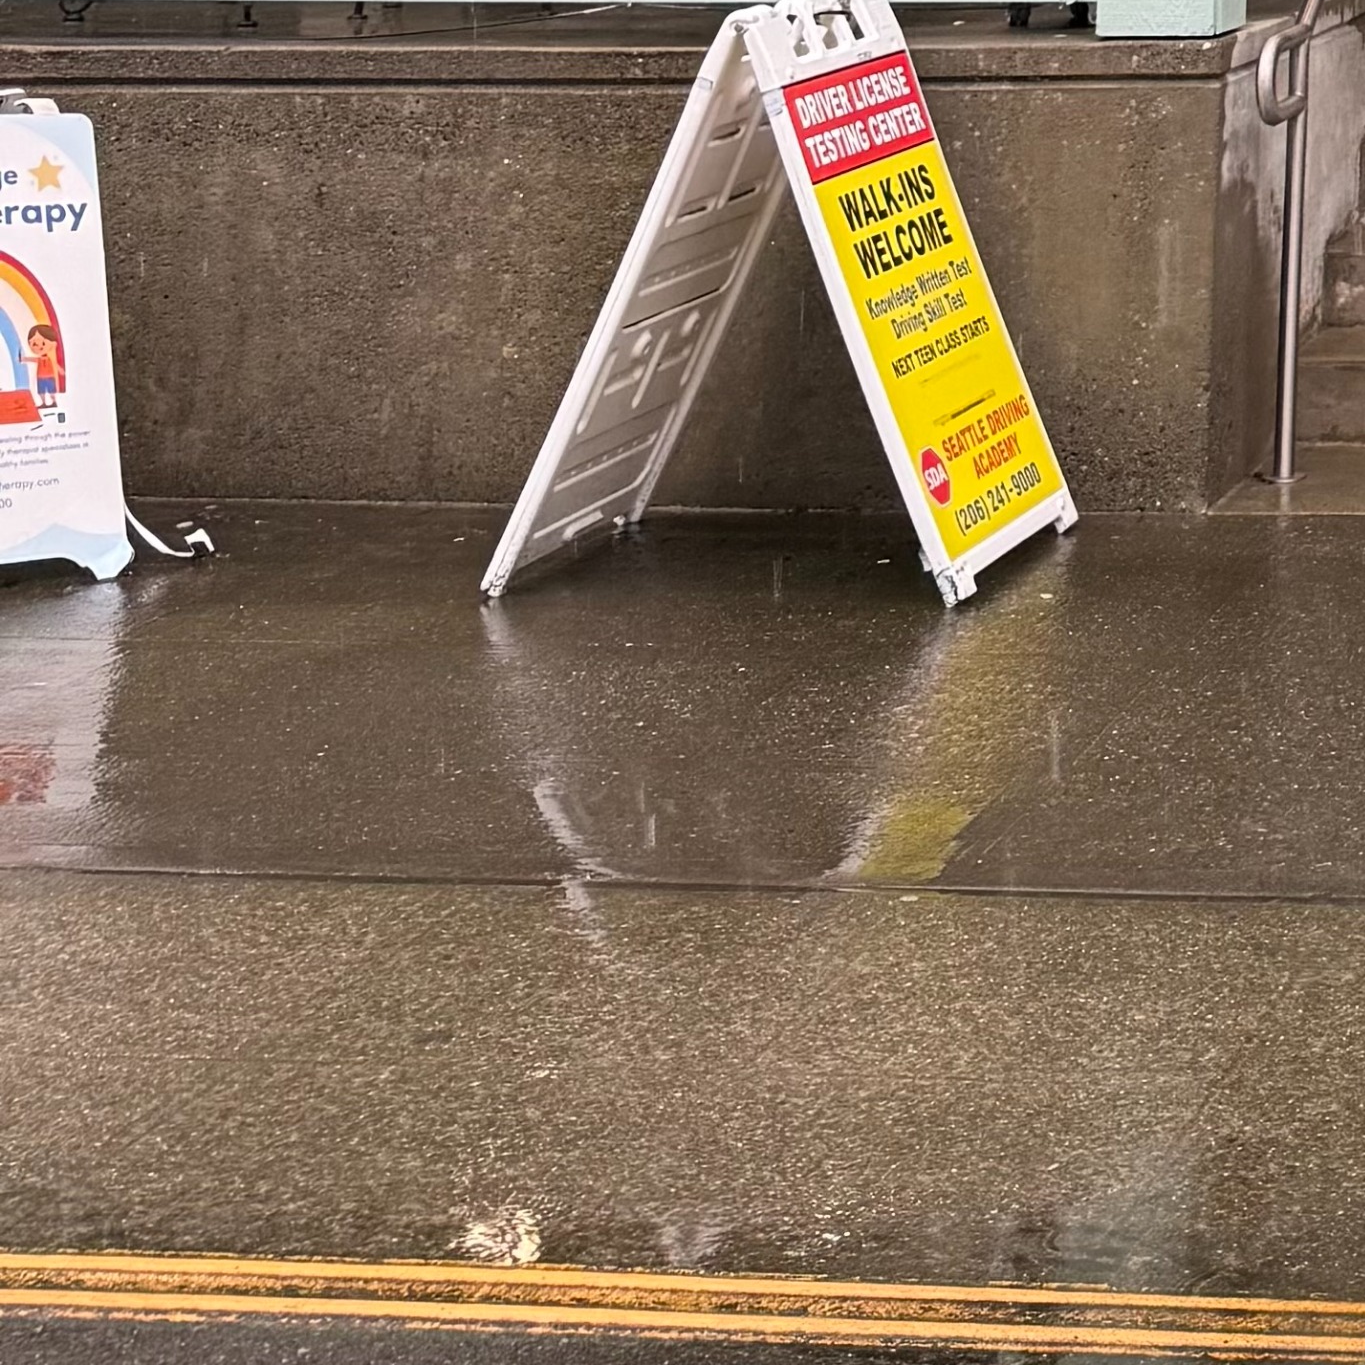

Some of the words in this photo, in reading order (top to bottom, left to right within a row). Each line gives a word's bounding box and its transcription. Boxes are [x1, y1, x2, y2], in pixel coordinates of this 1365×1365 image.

[795, 84, 853, 129] DRIVER
[850, 66, 911, 111] LICENSE
[804, 120, 870, 168] TESTING
[868, 102, 926, 146] CENTER
[0, 202, 88, 233] rapy
[838, 164, 935, 232] WALK-INS
[853, 207, 953, 279] WELCOME
[866, 284, 918, 320] Knowledge
[916, 268, 951, 296] Written
[948, 256, 972, 280] Test
[891, 311, 928, 339] Driving
[923, 296, 947, 323] Skill
[943, 288, 968, 312] Test
[892, 353, 915, 379] NEXT
[914, 343, 937, 367] TEEN
[935, 330, 962, 356] CLASS
[960, 315, 990, 343] STARTS
[942, 418, 988, 462] SEATTLE
[986, 394, 1030, 436] DRIVING
[973, 431, 1022, 479] ACADEMY
[924, 462, 948, 491] SDA
[955, 495, 991, 536] (206)
[987, 461, 1042, 513] 241-9000
